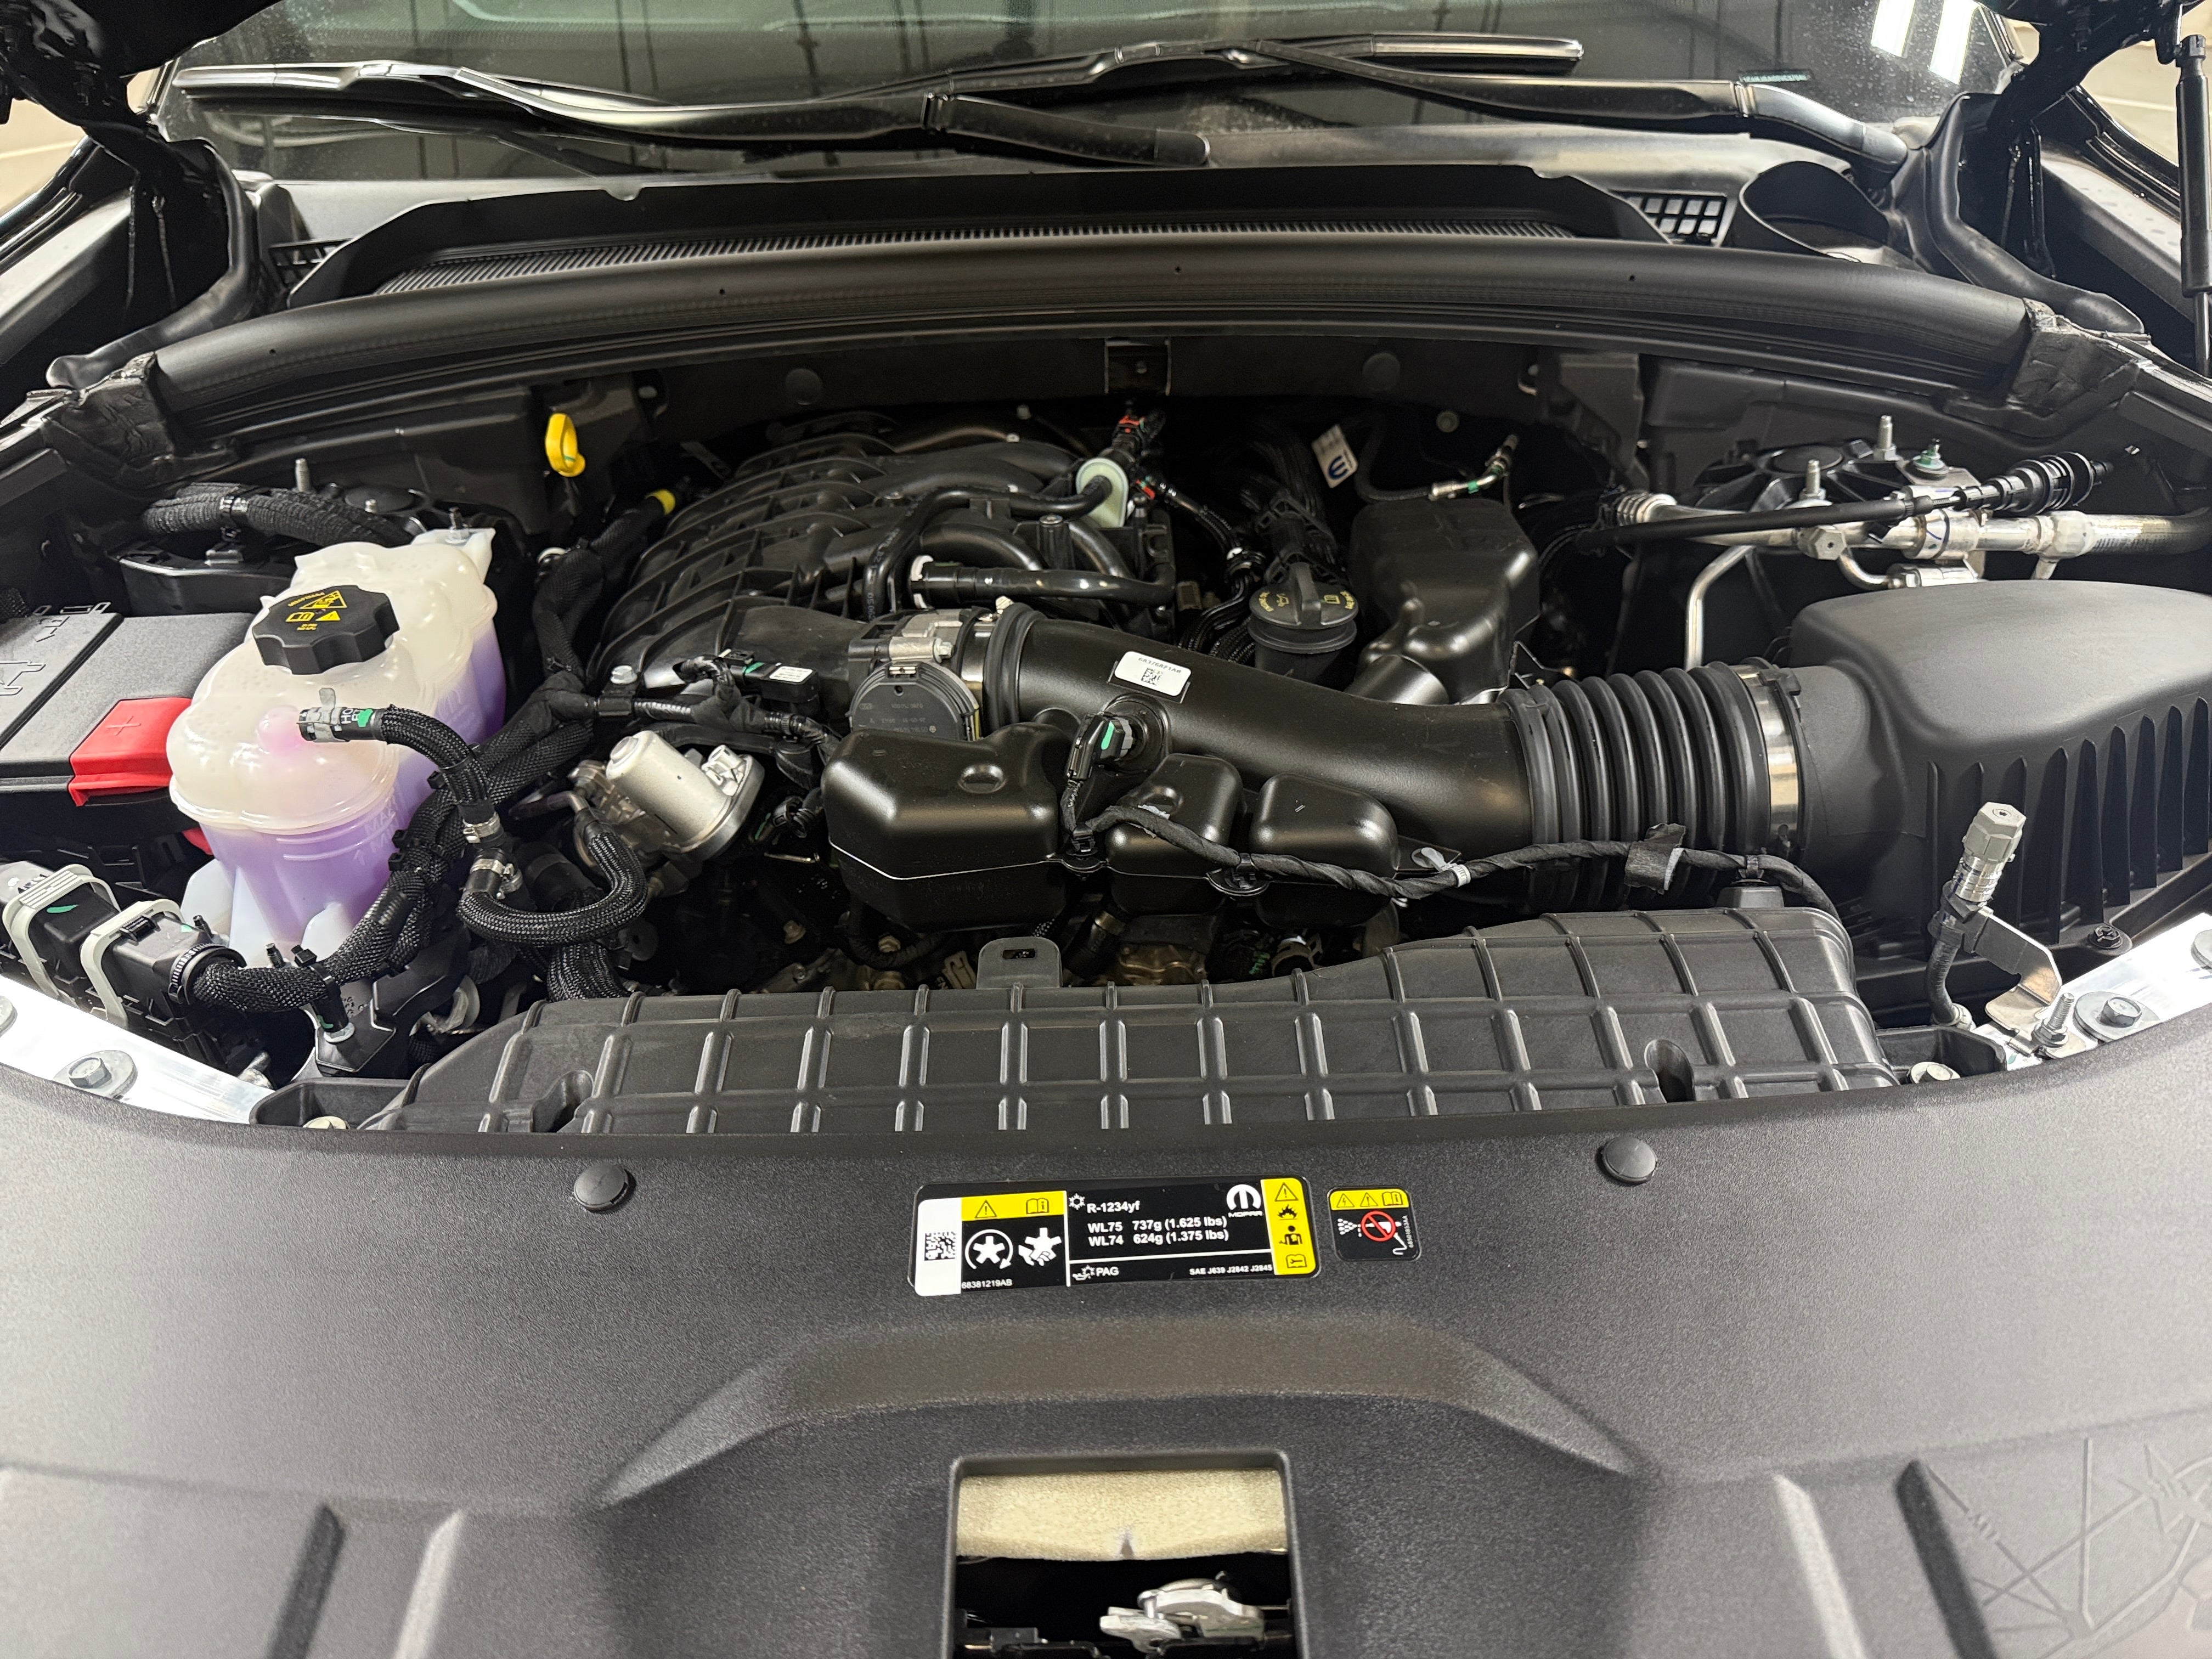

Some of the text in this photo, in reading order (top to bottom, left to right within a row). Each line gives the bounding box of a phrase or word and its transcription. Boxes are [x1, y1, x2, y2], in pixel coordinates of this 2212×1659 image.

[1087, 1200, 1141, 1214] R-1234yf
[1087, 1215, 1228, 1233] WL75 737g (1.625 lbs)
[1088, 1229, 1229, 1247] WL74 624g (1.375 lbs)
[1096, 1267, 1119, 1276] PAG
[1189, 1267, 1206, 1276] SAE
[1227, 1265, 1250, 1274] J2842
[1250, 1264, 1273, 1272] J2845
[961, 1279, 1013, 1289] 68381219AB
